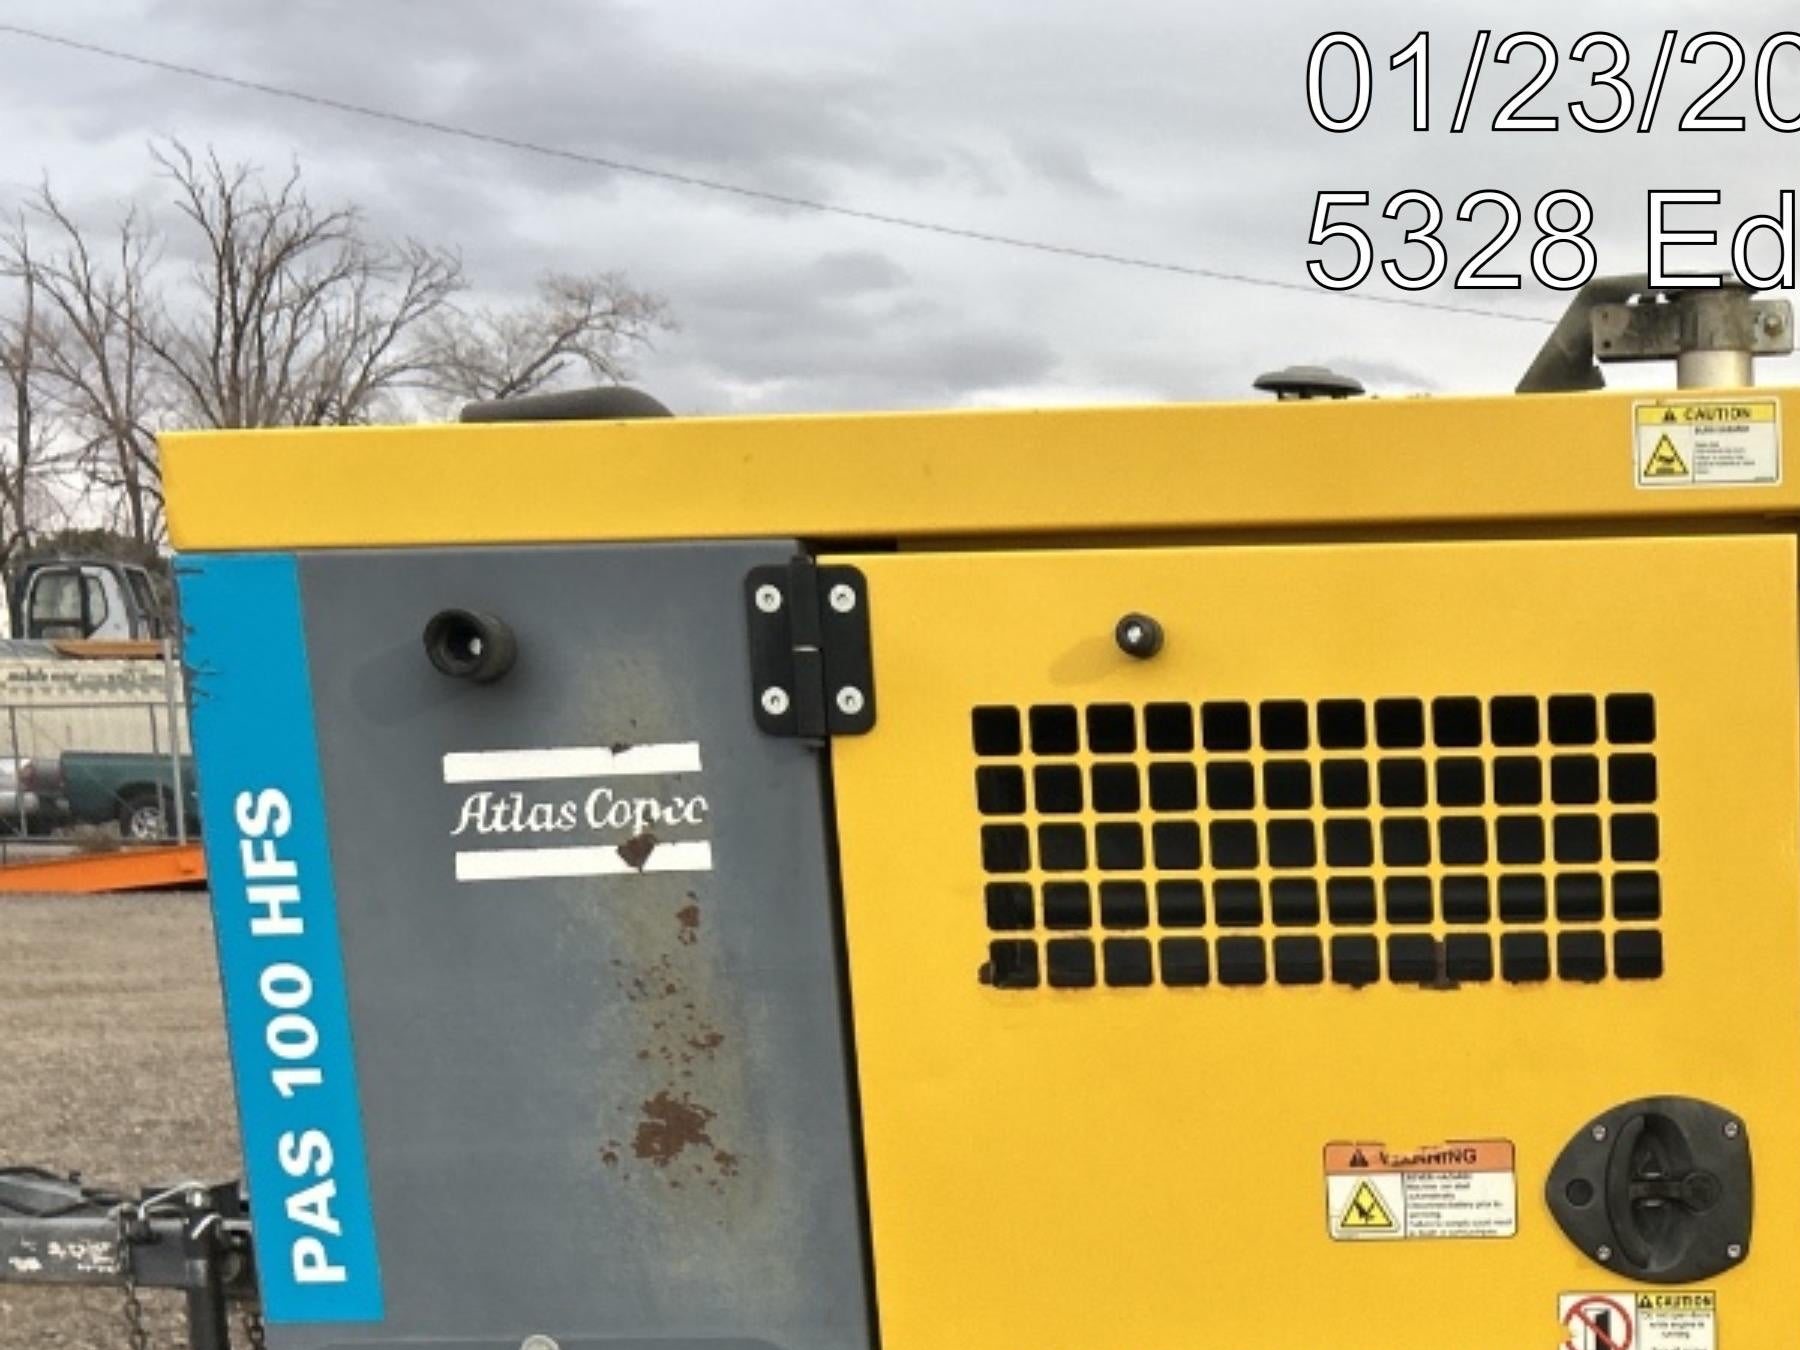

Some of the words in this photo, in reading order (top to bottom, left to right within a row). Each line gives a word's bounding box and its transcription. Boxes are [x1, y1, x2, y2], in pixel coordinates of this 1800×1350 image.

[235, 787, 304, 938] HFS
[451, 791, 577, 835] Atlas
[260, 962, 322, 1098] 100
[278, 1128, 348, 1285] PAS
